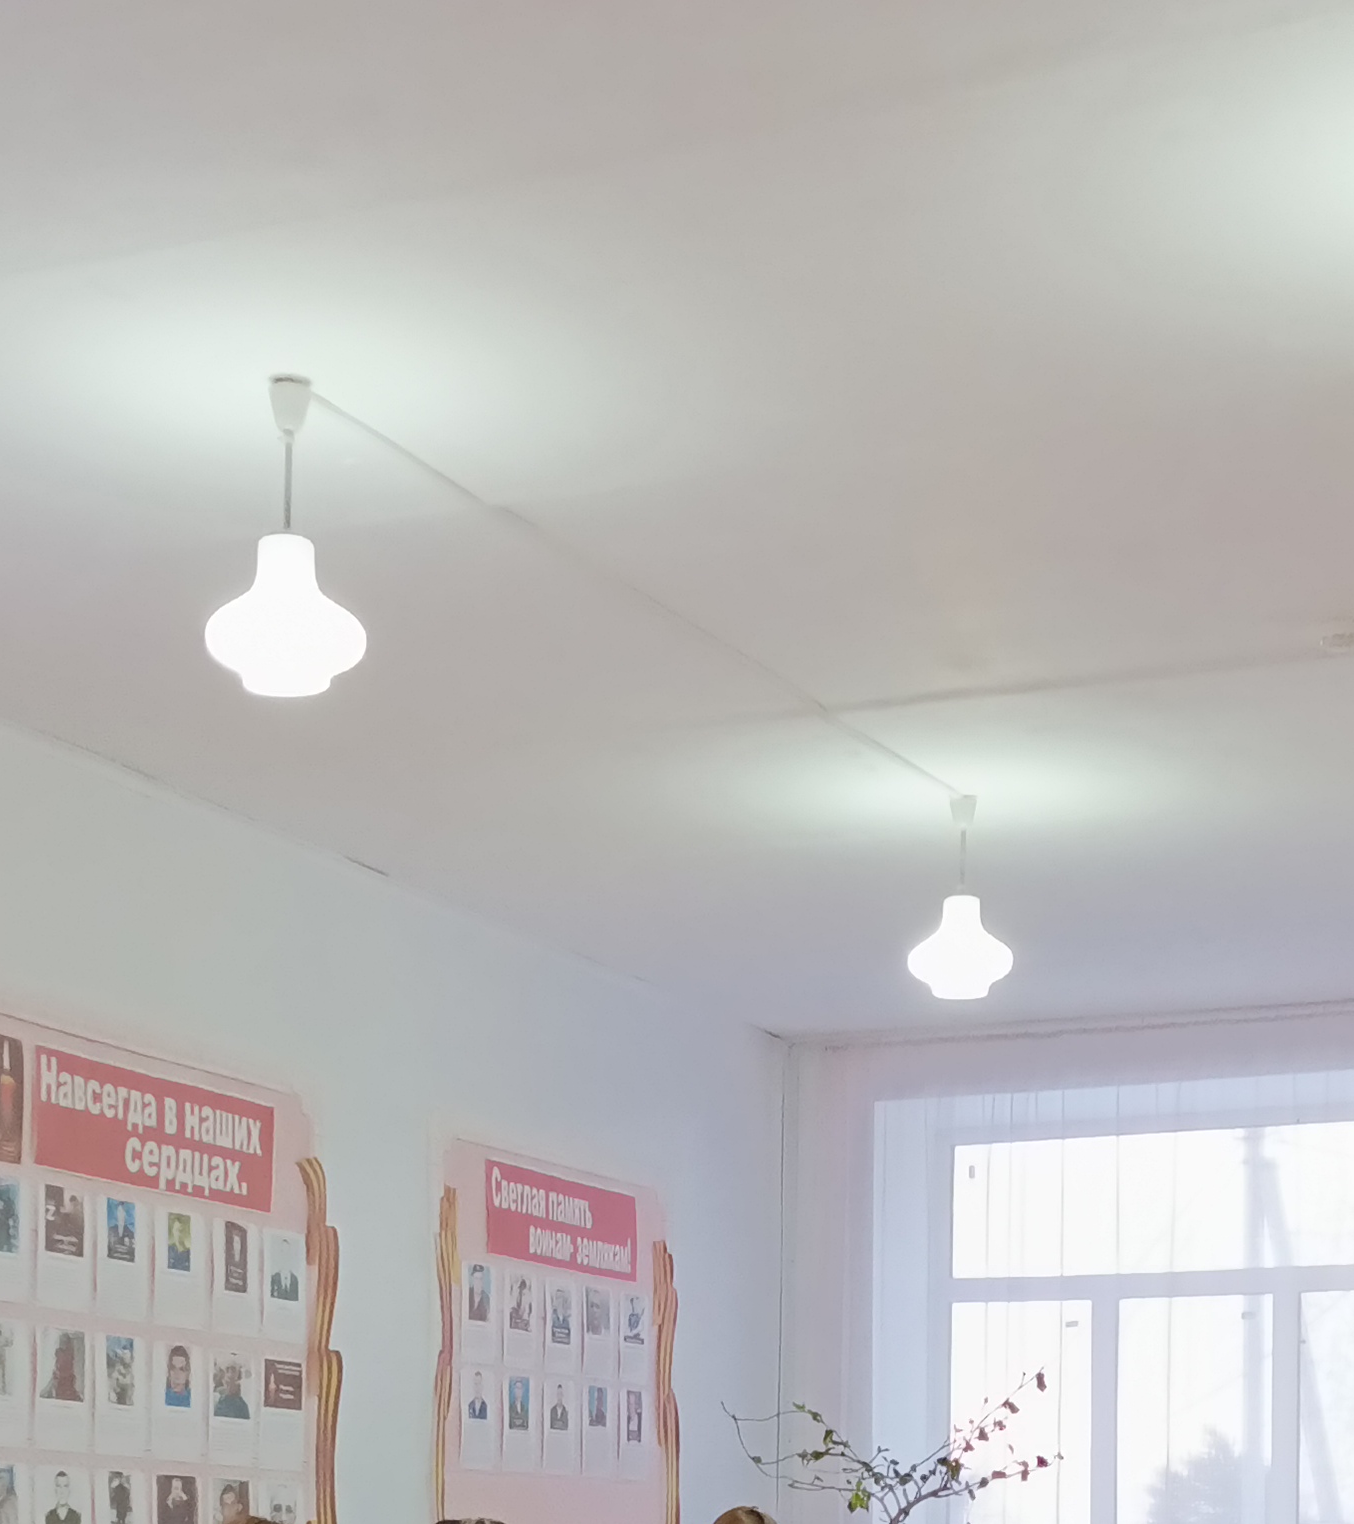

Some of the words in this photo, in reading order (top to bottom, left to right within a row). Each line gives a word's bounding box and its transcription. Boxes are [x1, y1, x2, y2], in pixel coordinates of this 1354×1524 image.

[40, 1054, 158, 1134] Навсегда
[163, 1096, 178, 1136] в
[184, 1101, 263, 1157] наших
[124, 1136, 248, 1197] сердцах.
[491, 1165, 546, 1219] Светлая
[548, 1190, 594, 1230] память
